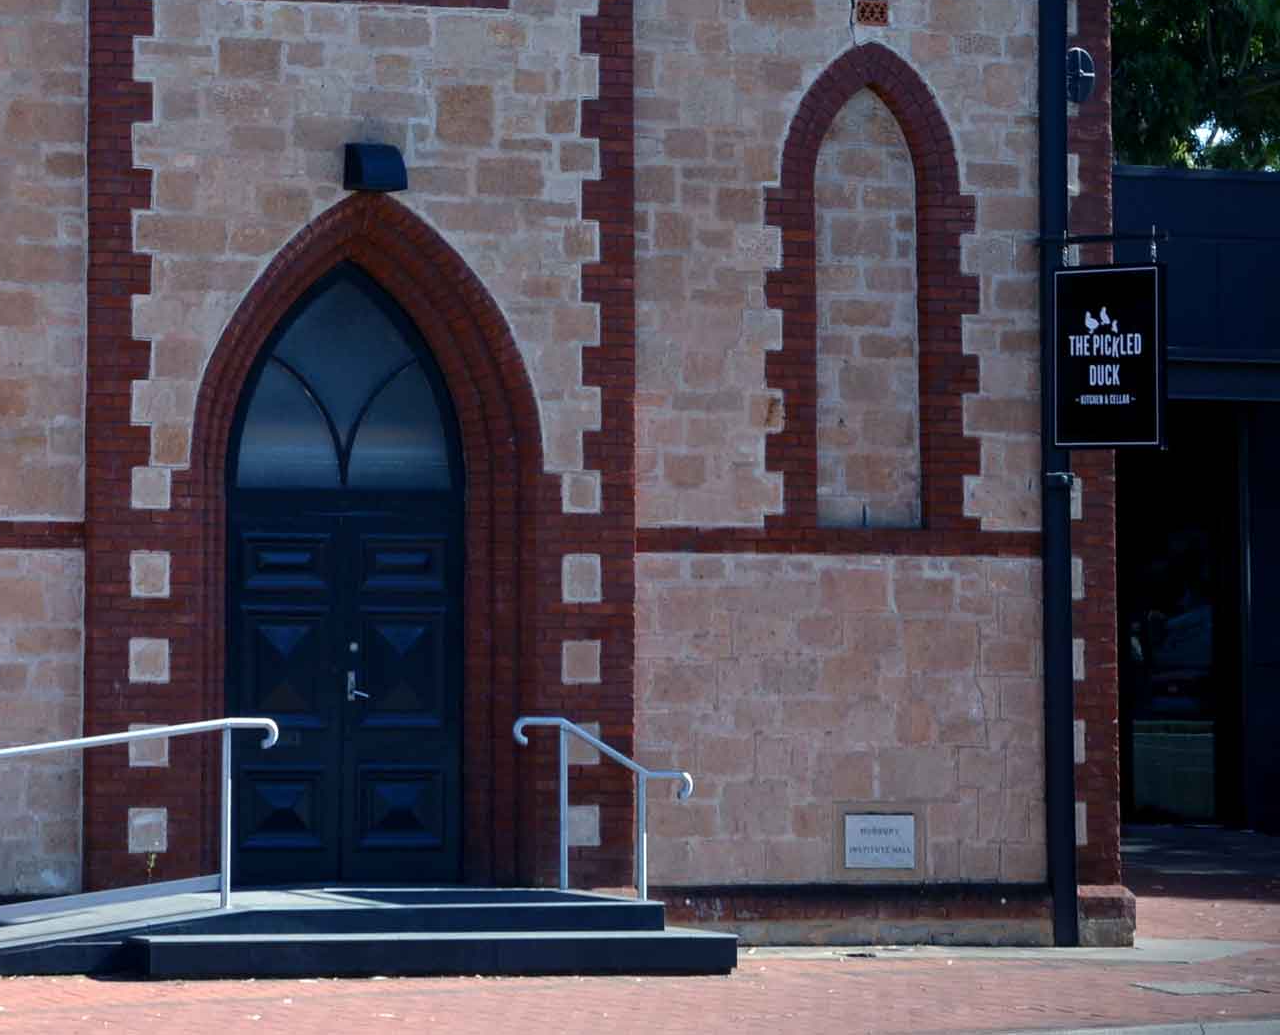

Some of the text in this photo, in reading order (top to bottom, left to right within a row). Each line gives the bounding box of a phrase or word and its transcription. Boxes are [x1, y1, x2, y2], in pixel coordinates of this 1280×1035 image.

[1069, 333, 1142, 358] THE PICKLED
[1089, 364, 1120, 387] DUCK
